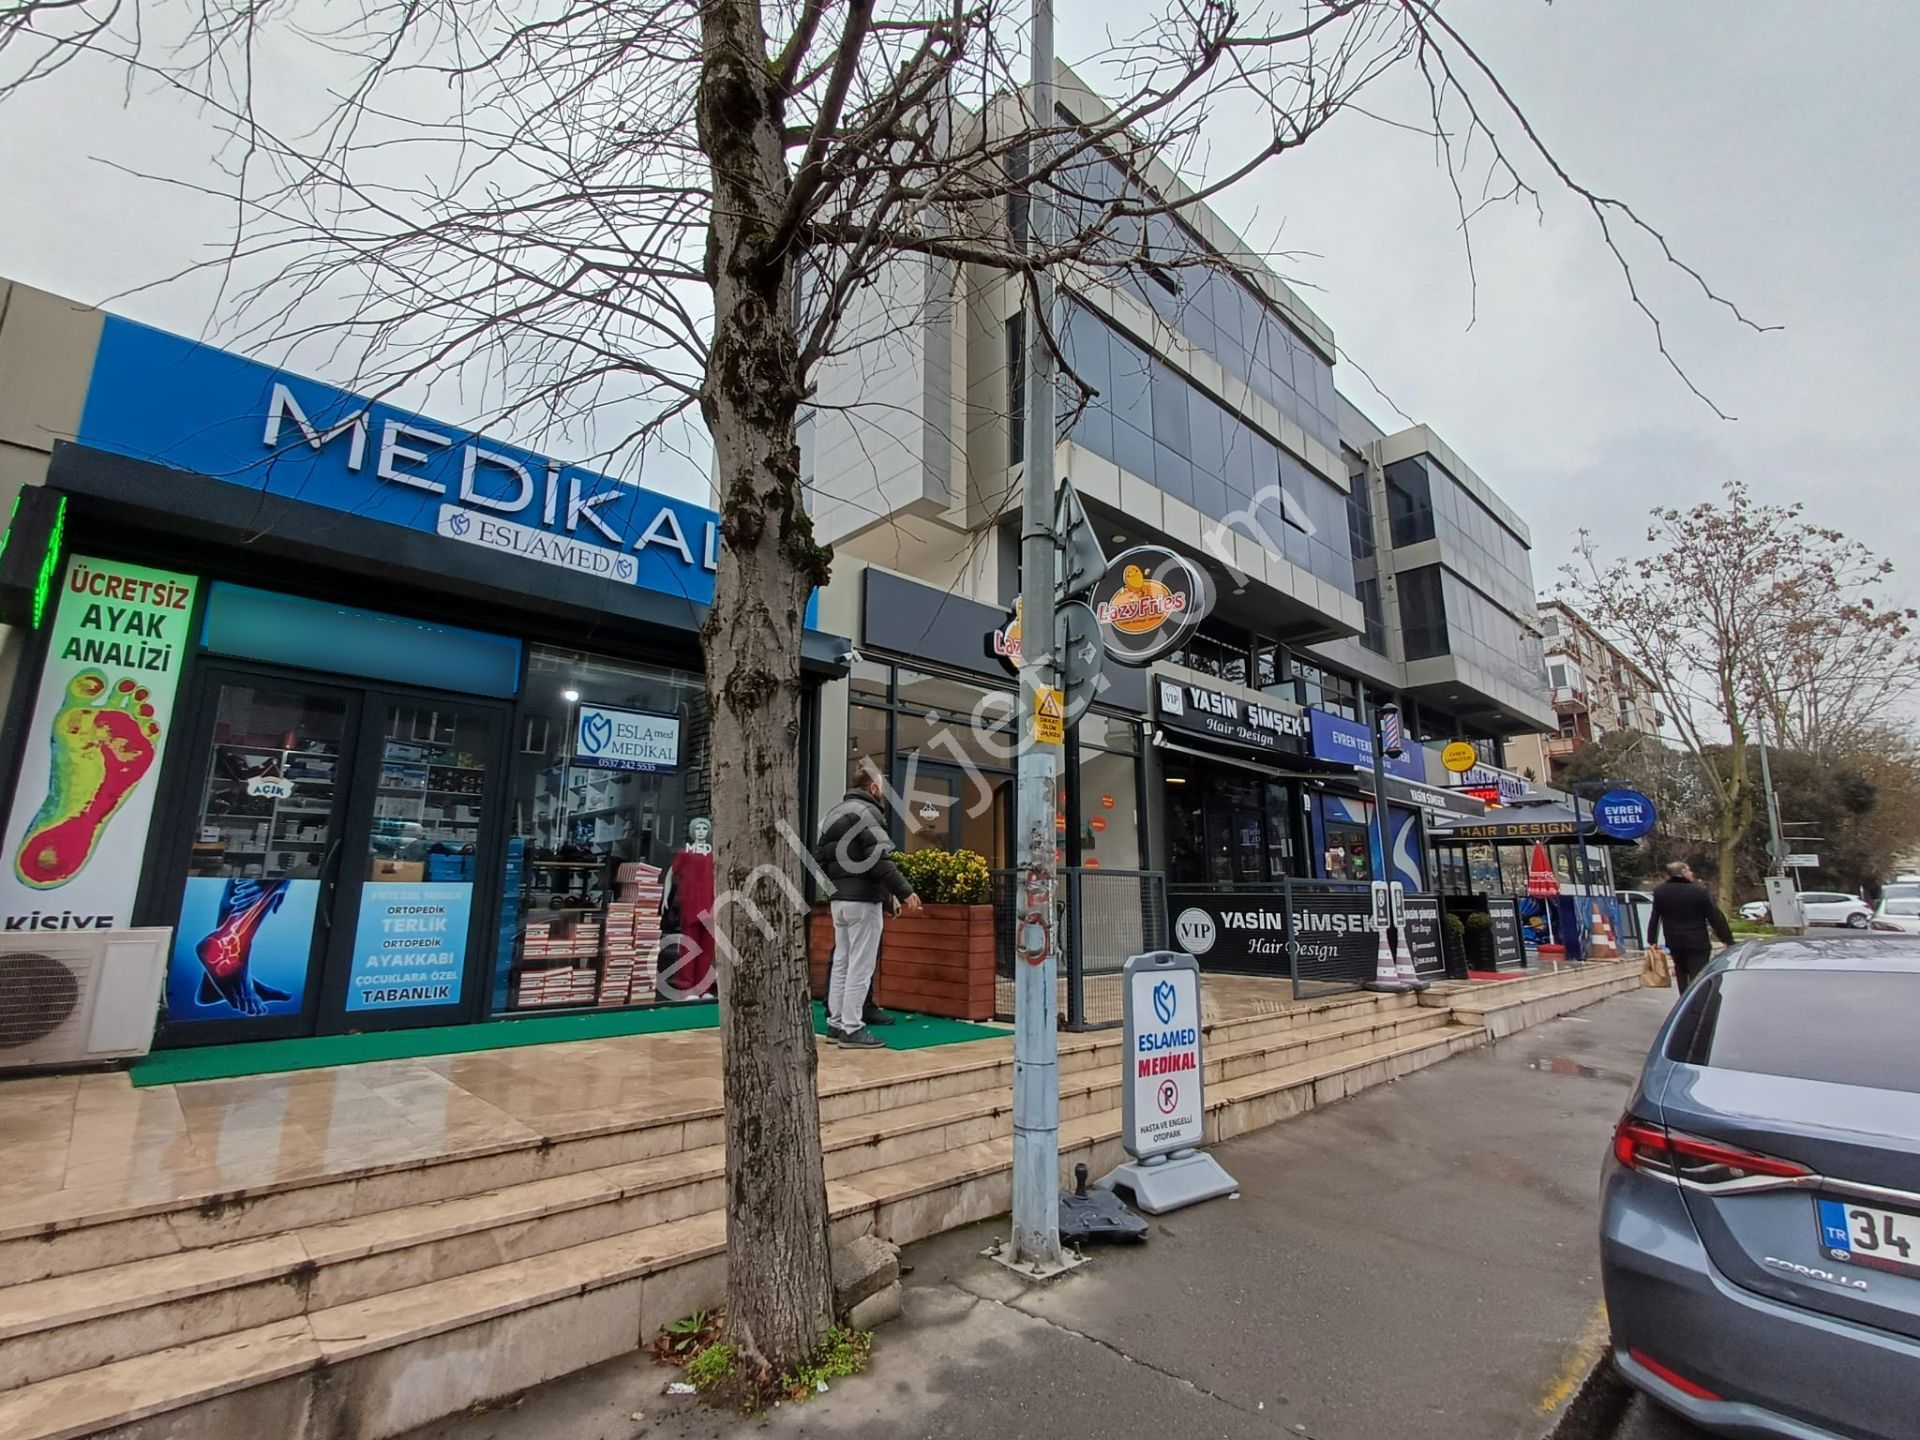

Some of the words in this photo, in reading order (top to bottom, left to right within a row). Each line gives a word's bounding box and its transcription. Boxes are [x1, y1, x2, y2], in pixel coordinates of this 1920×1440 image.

[478, 522, 610, 573] ESLAMED
[71, 564, 189, 610] ÜCRETSİZ
[80, 603, 167, 639] AYAK
[61, 637, 172, 671] ANALİZİ
[1165, 692, 1179, 705] VIP
[1190, 687, 1238, 719] YASİN
[1248, 703, 1302, 736] ŞİMŞEK
[1206, 718, 1234, 735] Hair
[1236, 725, 1274, 746] Design
[1332, 731, 1356, 749] EVREN
[612, 741, 676, 760] MEDİKAL
[620, 761, 636, 770] 242
[254, 785, 284, 796] AÇIK
[1604, 805, 1643, 815] EVREN
[1606, 814, 1643, 824] TEKEL
[1460, 826, 1496, 837] HAIR
[1507, 822, 1573, 836] DESIGN
[387, 904, 446, 915] ORTOPEDİK
[382, 917, 448, 933] TERLİK
[1220, 909, 1282, 930] YASİN
[1181, 922, 1211, 939] VIP
[383, 937, 442, 948] ORTOPEDİK
[1248, 938, 1283, 954] Hair
[365, 952, 454, 968] AYAKKABI
[356, 972, 427, 986] ÇOCUKLARA
[362, 986, 449, 1003] TABANLIK
[1139, 1028, 1196, 1052] ESLAMED
[1138, 1052, 1196, 1078] MEDİKAL
[1140, 1123, 1160, 1134] HASTA
[1160, 1120, 1168, 1130] VE
[1169, 1113, 1193, 1128] ENGELLİ
[1826, 1227, 1848, 1241] TR
[1850, 1210, 1911, 1258] 34
[1764, 1256, 1868, 1292] COROLLA
